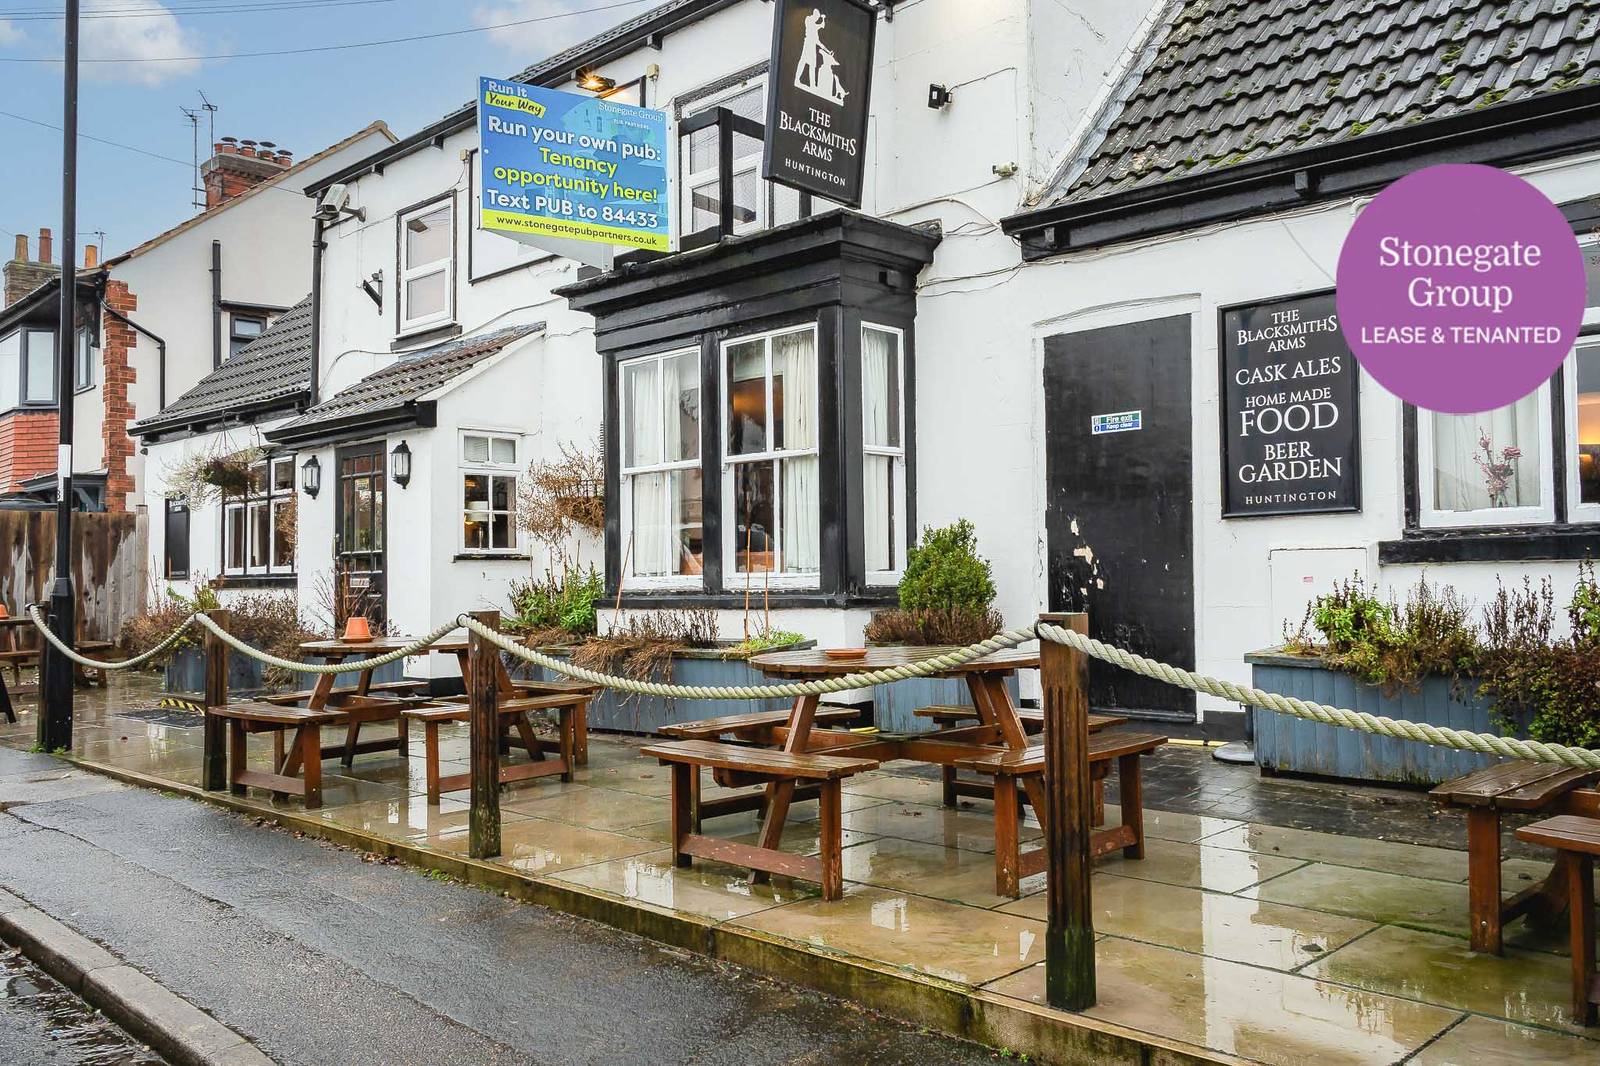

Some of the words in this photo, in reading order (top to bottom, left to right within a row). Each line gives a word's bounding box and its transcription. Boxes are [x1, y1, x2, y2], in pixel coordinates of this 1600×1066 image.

[488, 81, 514, 95] Run
[488, 92, 514, 107] Your
[518, 99, 542, 116] Way
[598, 102, 638, 116] Stonegate
[639, 110, 663, 123] Group
[808, 107, 831, 128] THE
[488, 115, 527, 137] Run
[531, 126, 575, 144] your
[579, 132, 617, 153] own
[622, 142, 662, 161] pub:
[779, 110, 857, 156] BLACKSMITHS
[539, 147, 618, 178] Tenancy
[802, 141, 833, 162] ARMS
[493, 166, 609, 199] opportunity
[613, 181, 658, 204] here!
[785, 158, 846, 186] HUNTINGTON
[487, 189, 531, 210] Text
[535, 196, 573, 216] PUB
[578, 203, 597, 219] to
[602, 206, 658, 229] 84433
[496, 215, 657, 246] www.stonegatepubpartners.co.uk
[1271, 309, 1300, 324] THE
[1237, 315, 1337, 346] BLACKSMITHS
[1267, 336, 1306, 353] ARMS
[1235, 363, 1288, 386] CASK
[1291, 356, 1342, 379] ALES
[1245, 392, 1286, 408] HOME
[1290, 387, 1332, 402] MADE
[1239, 401, 1339, 437] FOOD
[1264, 441, 1314, 461] BEER
[1238, 457, 1342, 484] GARDEN
[1245, 490, 1337, 505] HUNTINGTON
